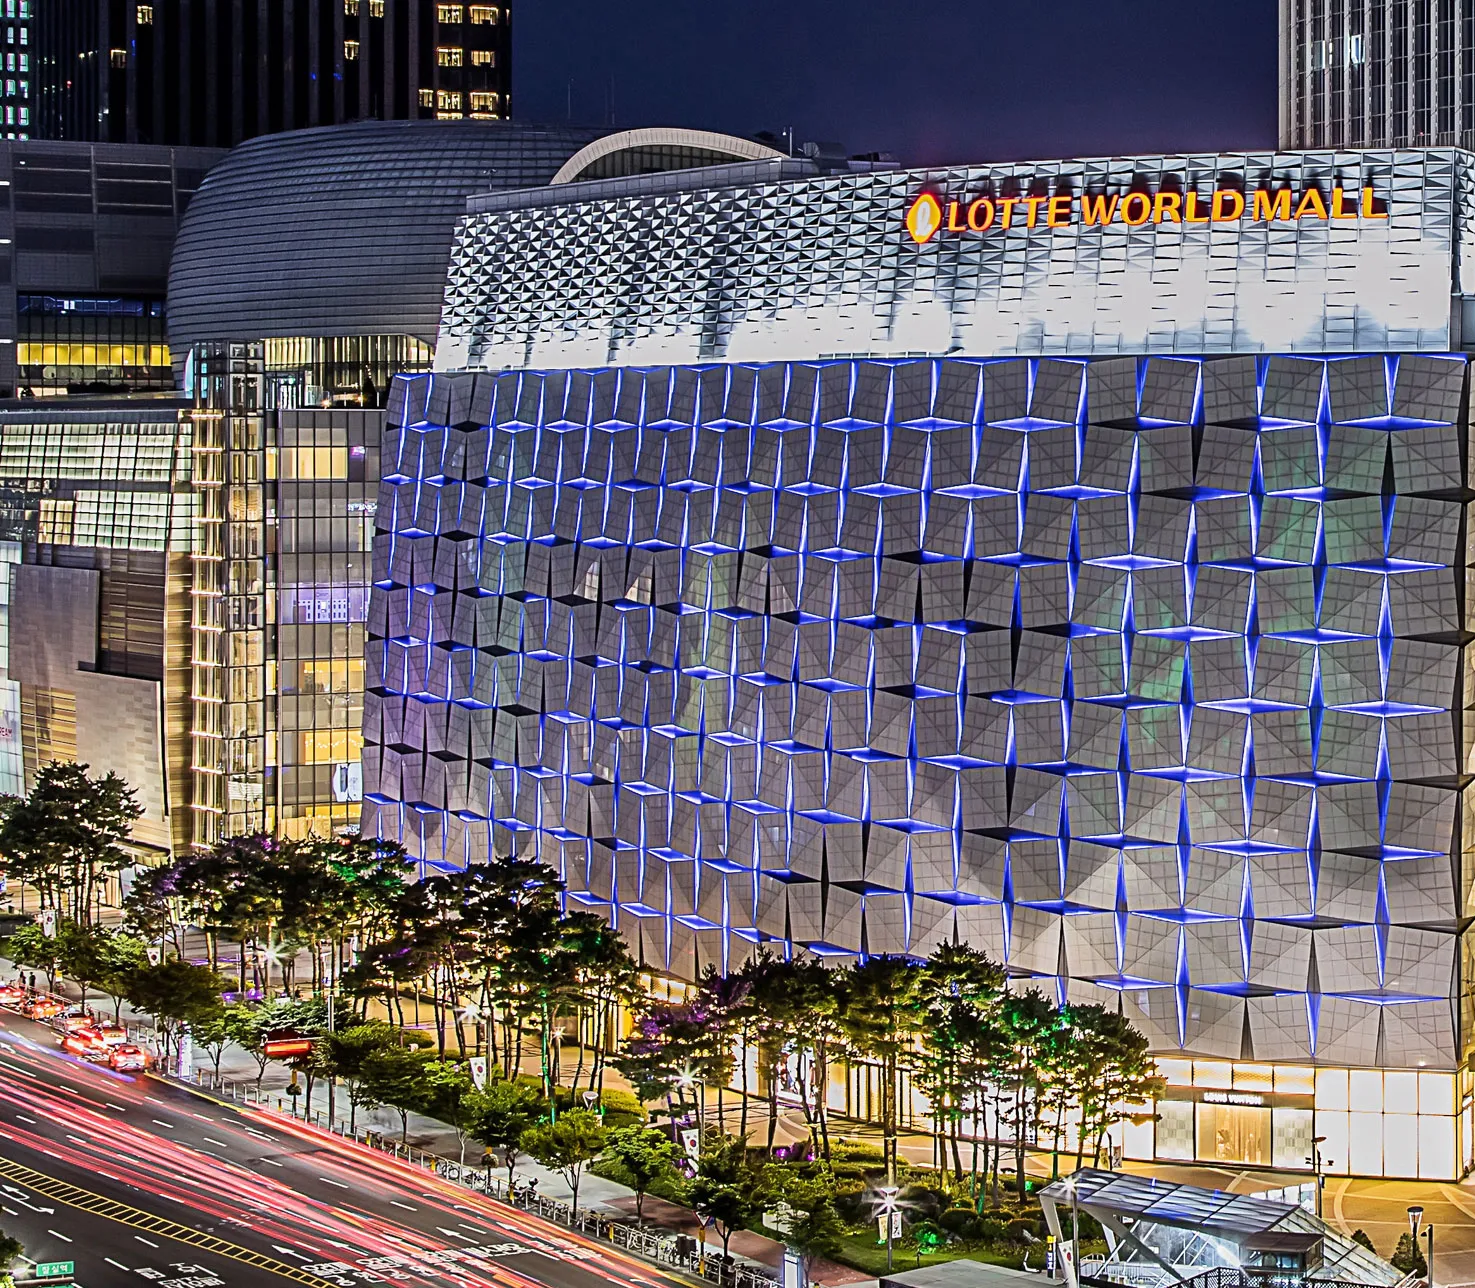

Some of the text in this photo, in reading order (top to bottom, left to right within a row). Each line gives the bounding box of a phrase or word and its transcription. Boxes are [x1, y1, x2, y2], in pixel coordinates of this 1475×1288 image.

[948, 187, 1389, 232] LOTTE WORLD MALL
